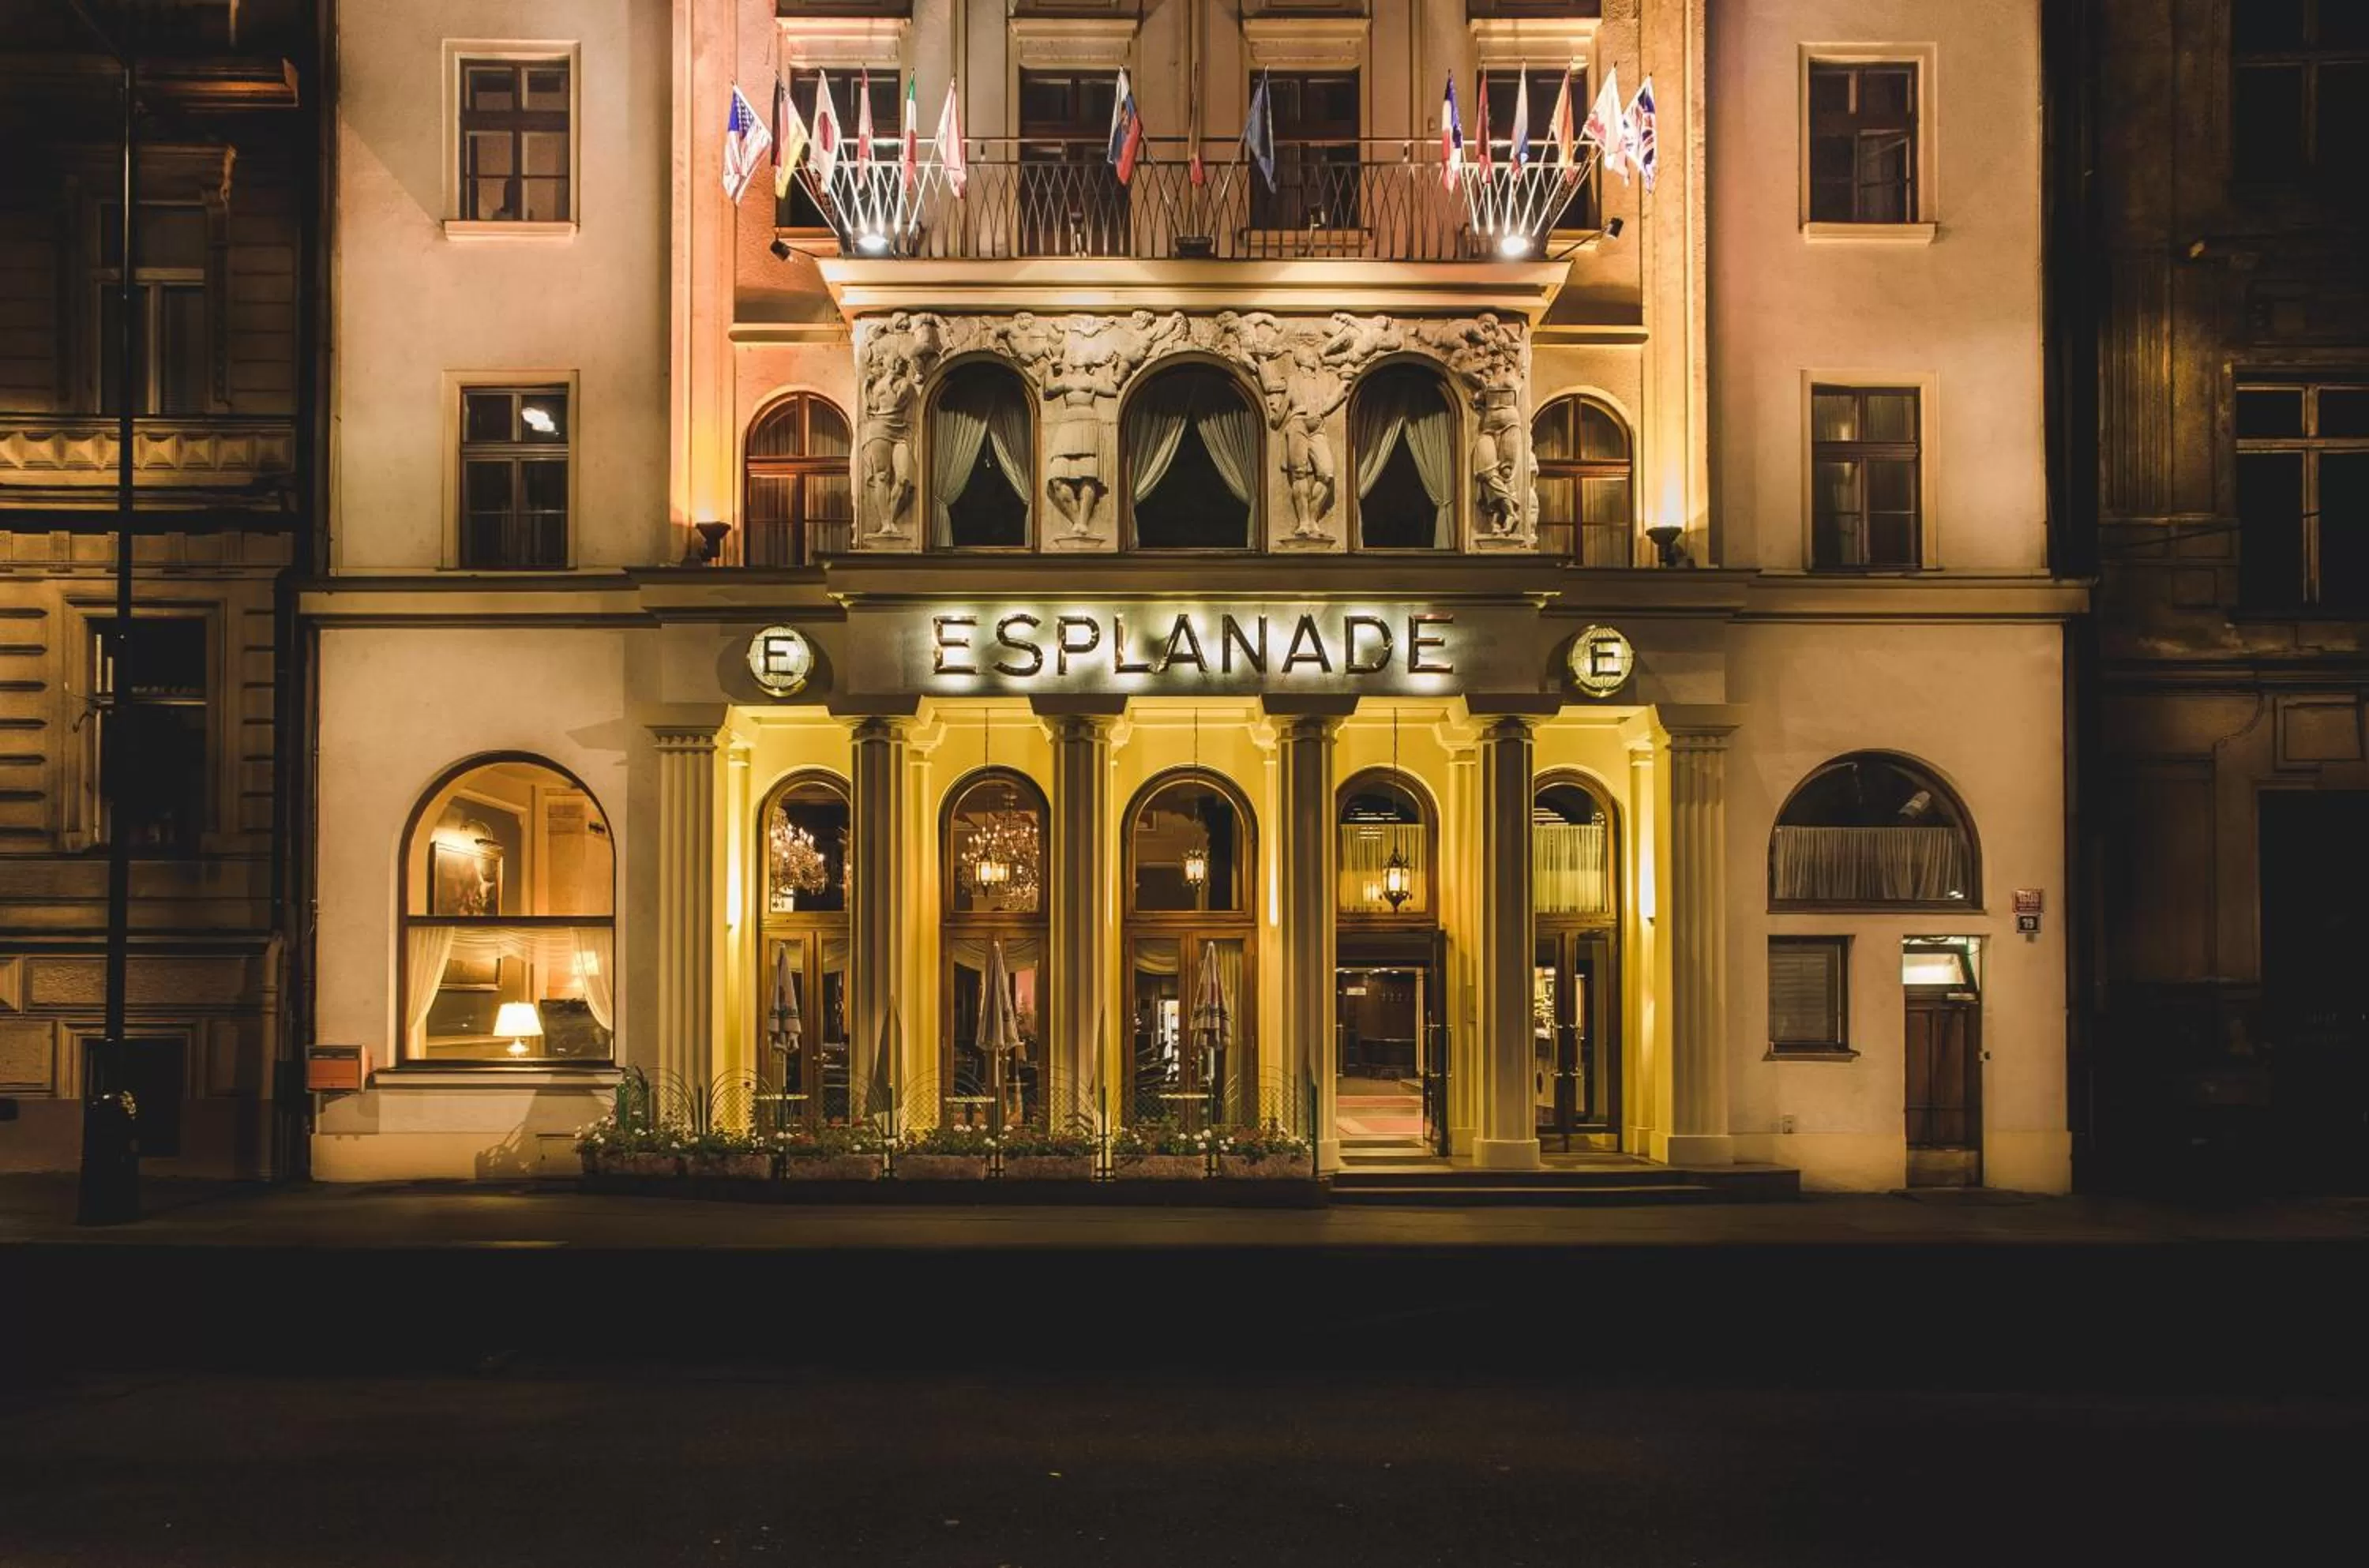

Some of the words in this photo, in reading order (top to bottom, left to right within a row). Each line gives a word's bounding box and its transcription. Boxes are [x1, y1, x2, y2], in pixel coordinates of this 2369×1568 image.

[764, 636, 796, 677] E
[933, 613, 1454, 677] ESPLANADE
[1590, 637, 1621, 677] E
